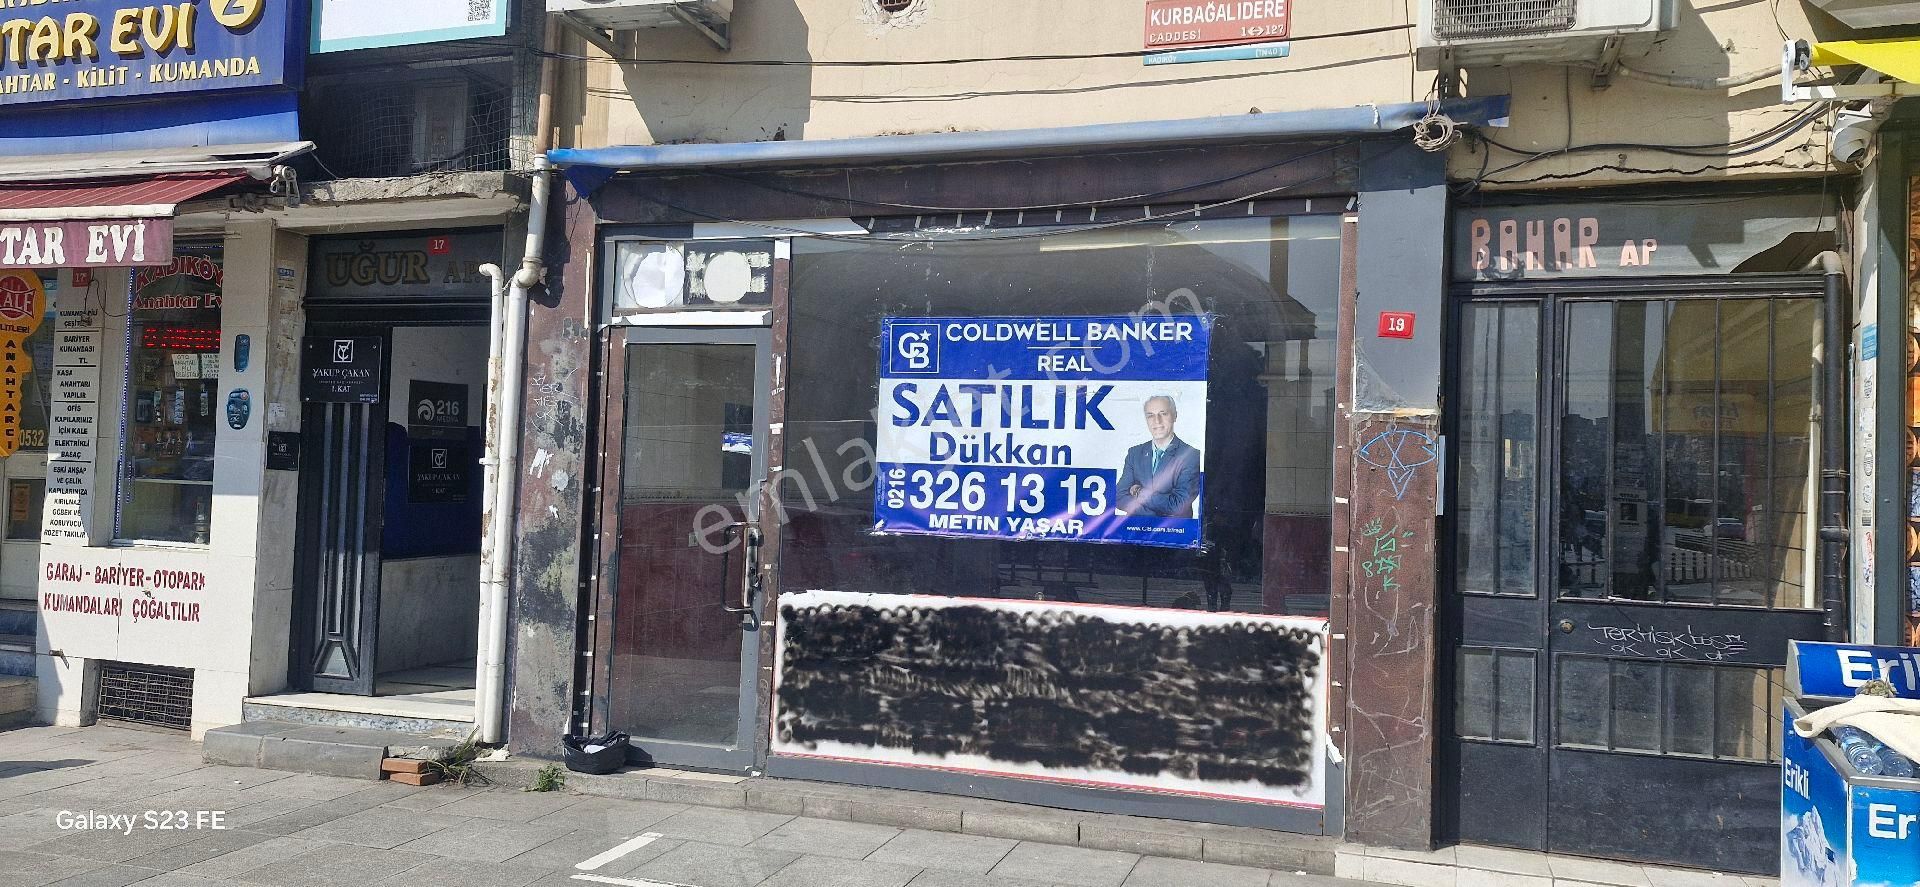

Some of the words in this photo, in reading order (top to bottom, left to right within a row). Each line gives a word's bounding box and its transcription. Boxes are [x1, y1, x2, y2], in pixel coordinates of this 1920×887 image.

[1151, 0, 1284, 26] KURBAĞALIDERE
[78, 65, 128, 88] KİLİT
[150, 57, 261, 83] KUMANDA
[86, 219, 145, 262] EVİ
[434, 240, 444, 250] 17
[1471, 217, 1599, 270] BAHAR
[1620, 239, 1657, 266] AP
[326, 241, 430, 287] UĞUR
[946, 322, 1080, 342] COLDWELL
[1087, 322, 1193, 342] BANKER
[1387, 317, 1405, 331] 19
[312, 368, 340, 378] YAKUP
[341, 368, 370, 379] ÇAKAN
[1038, 354, 1092, 371] REAL
[4, 340, 17, 449] ANAHTARCI
[437, 400, 459, 416] 216
[892, 382, 1115, 431] SATILIK
[20, 430, 44, 446] 0532
[55, 439, 89, 447] ELEKTRİKLİ
[929, 431, 1071, 466] Dükkan
[887, 468, 906, 509] 0216
[910, 469, 986, 512] 326
[1000, 472, 1045, 514] 13
[1060, 474, 1107, 516] 13
[1006, 517, 1084, 537] YAŞAR
[46, 563, 82, 582] GARAJ
[95, 562, 144, 587] BARİYER
[154, 570, 206, 590] OTOPARK
[44, 593, 123, 616] KUMANDALARI
[133, 597, 200, 623] ÇOĞALTILIR
[1785, 757, 1809, 799] Erikli
